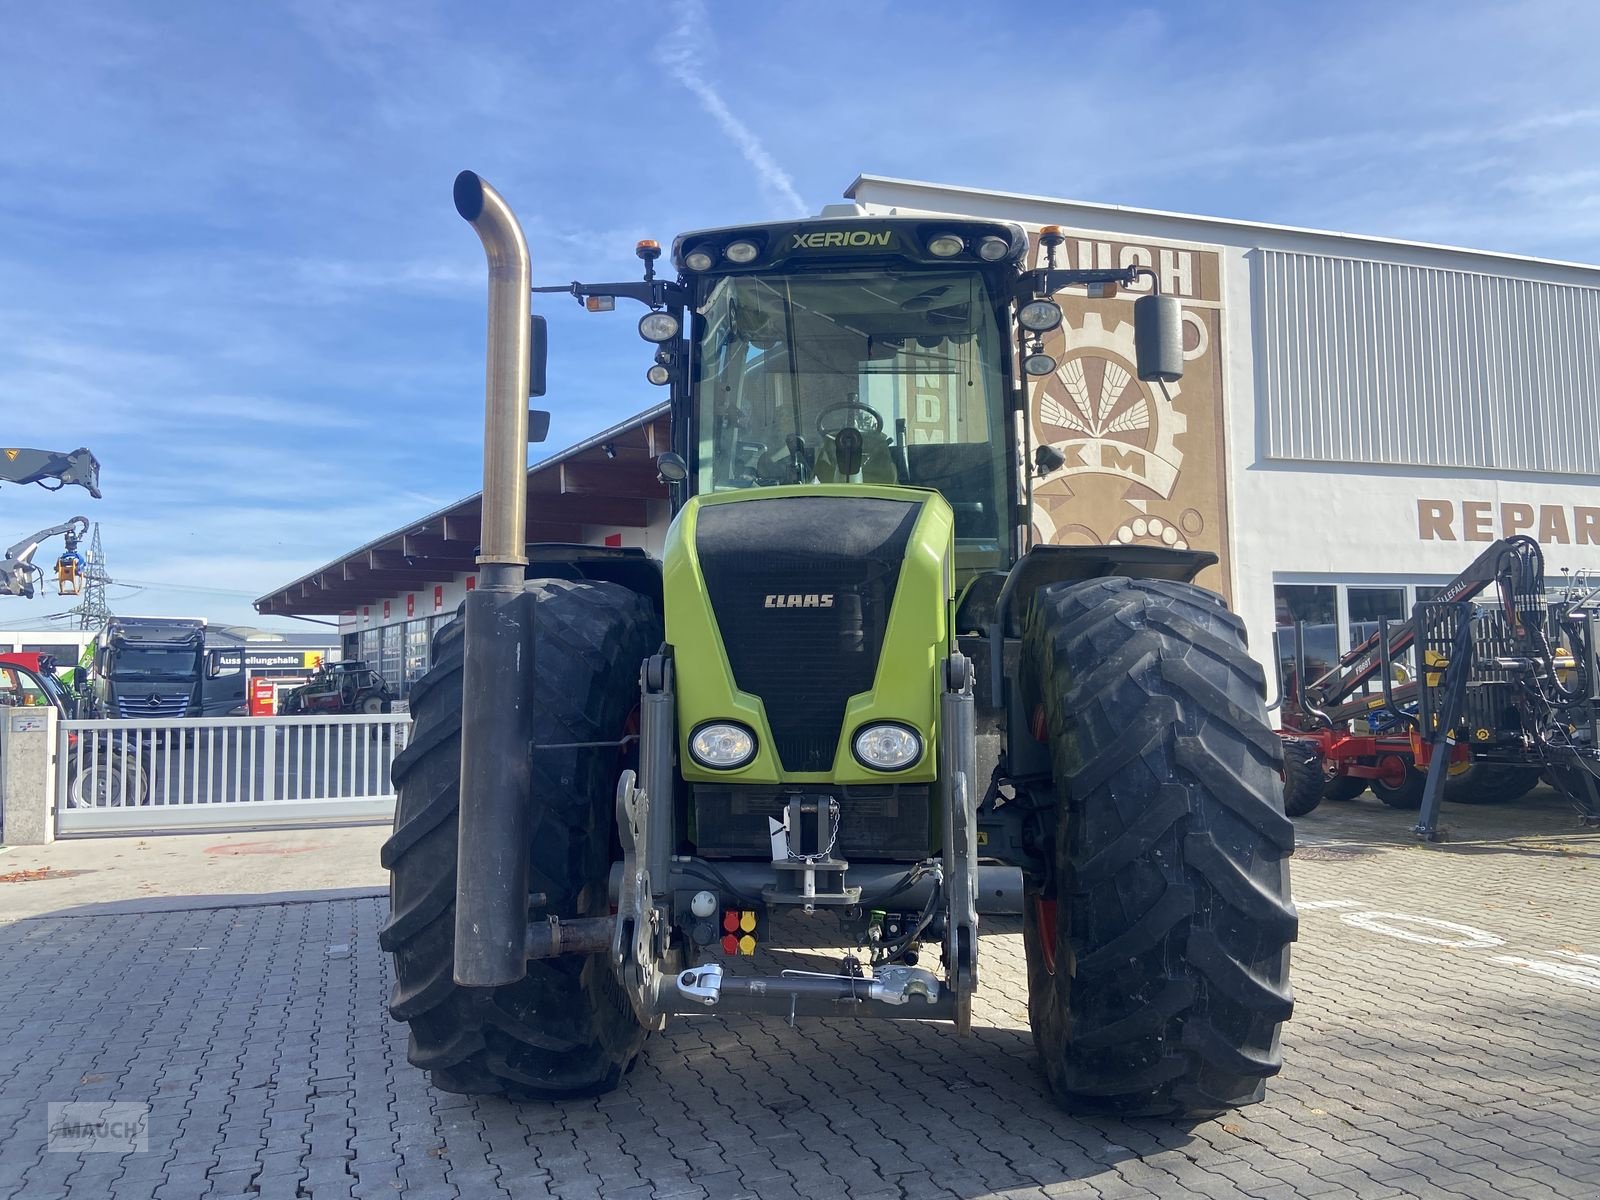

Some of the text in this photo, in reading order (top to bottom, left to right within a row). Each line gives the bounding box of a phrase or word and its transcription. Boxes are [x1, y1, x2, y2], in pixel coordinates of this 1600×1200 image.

[791, 230, 892, 249] XERION
[1416, 498, 1600, 545] REPAR
[764, 594, 834, 608] CLAAS
[219, 655, 299, 666] Aussellungshalle
